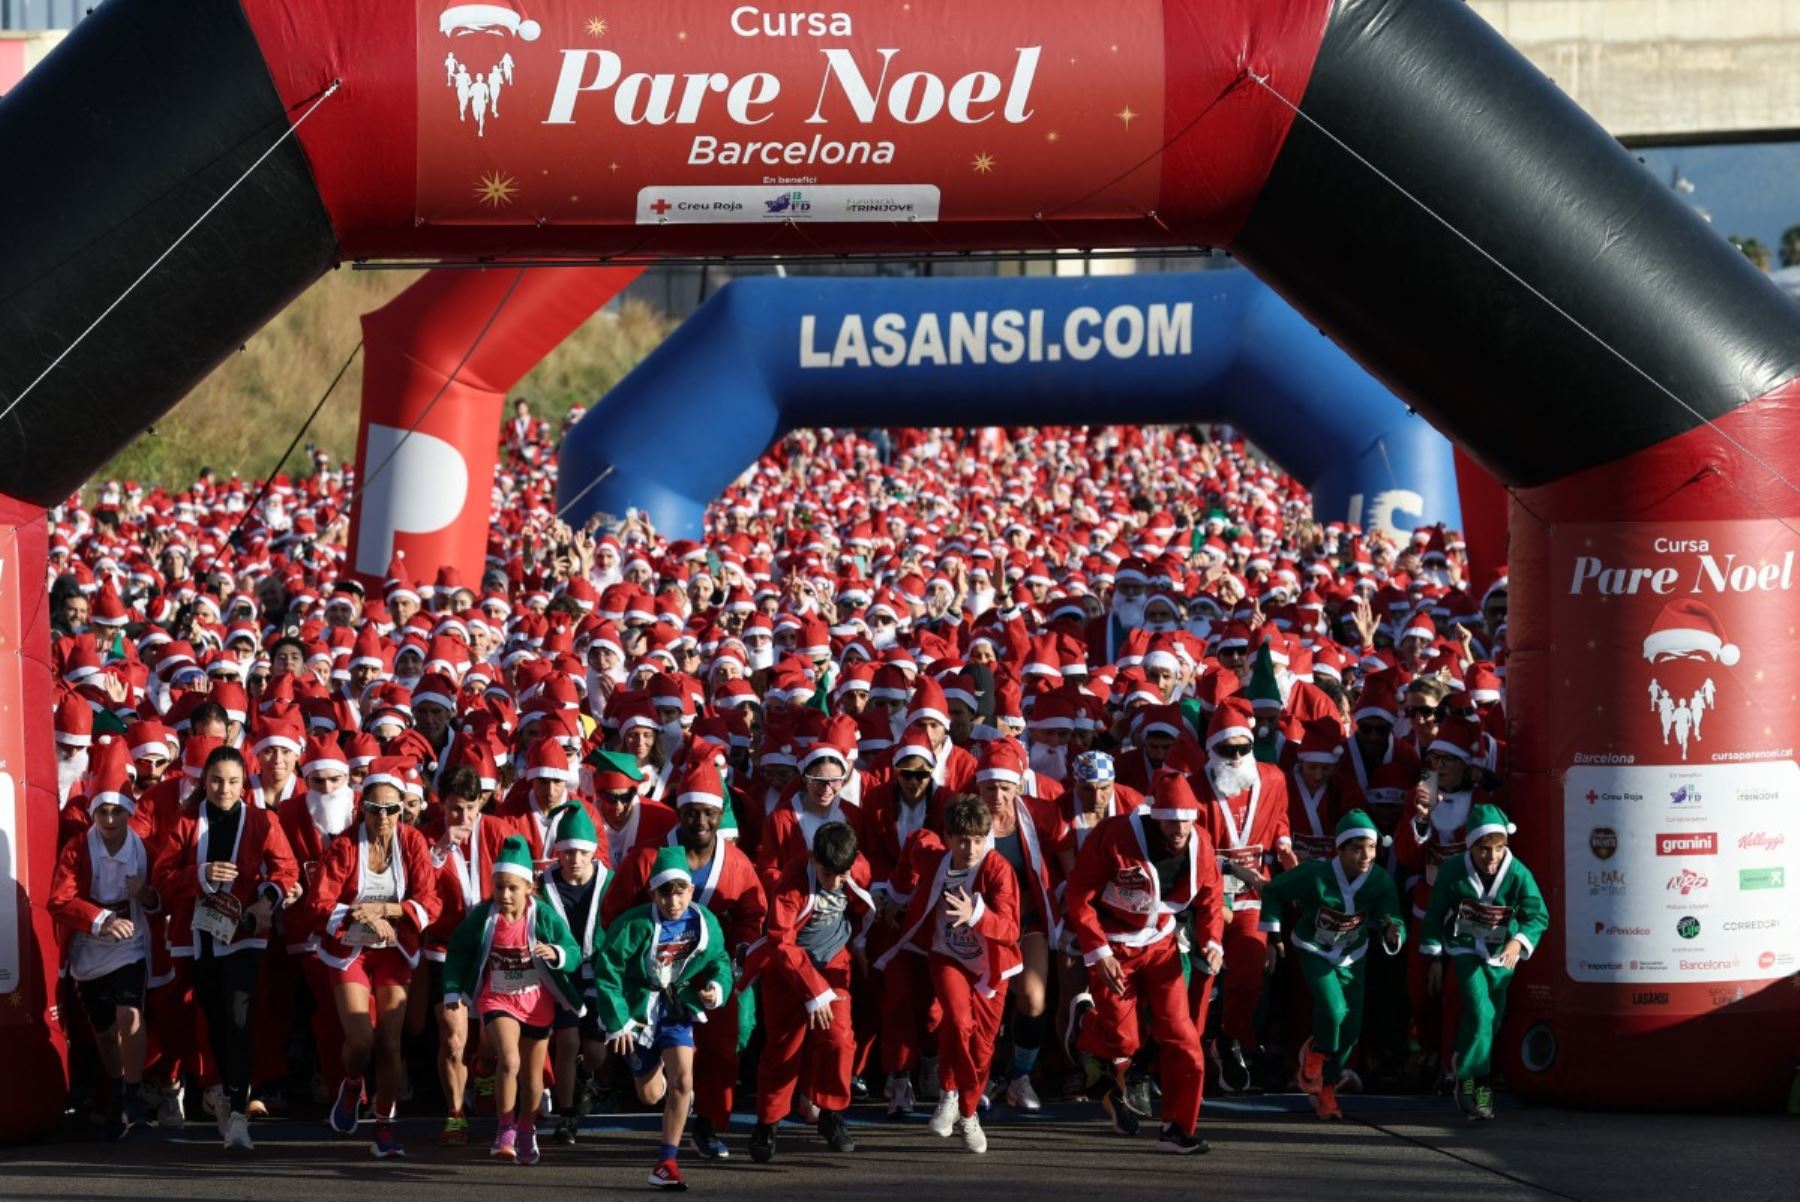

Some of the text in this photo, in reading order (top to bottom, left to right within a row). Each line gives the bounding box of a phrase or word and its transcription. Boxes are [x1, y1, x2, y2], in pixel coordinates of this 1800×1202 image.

[730, 6, 852, 37] Cursa
[542, 45, 1043, 125] Pare Noel
[687, 135, 896, 166] Barcelona
[778, 176, 817, 184] benefici
[678, 201, 743, 212] Creu Roja
[800, 303, 1193, 368] LASANSI.COM
[1654, 537, 1709, 553] Cursa
[1568, 550, 1795, 595] Pare Noel
[1573, 752, 1635, 765] Barcelona
[1601, 793, 1643, 802] Creu Roja
[1662, 835, 1712, 853] granini
[1679, 960, 1731, 971] Barcelona
